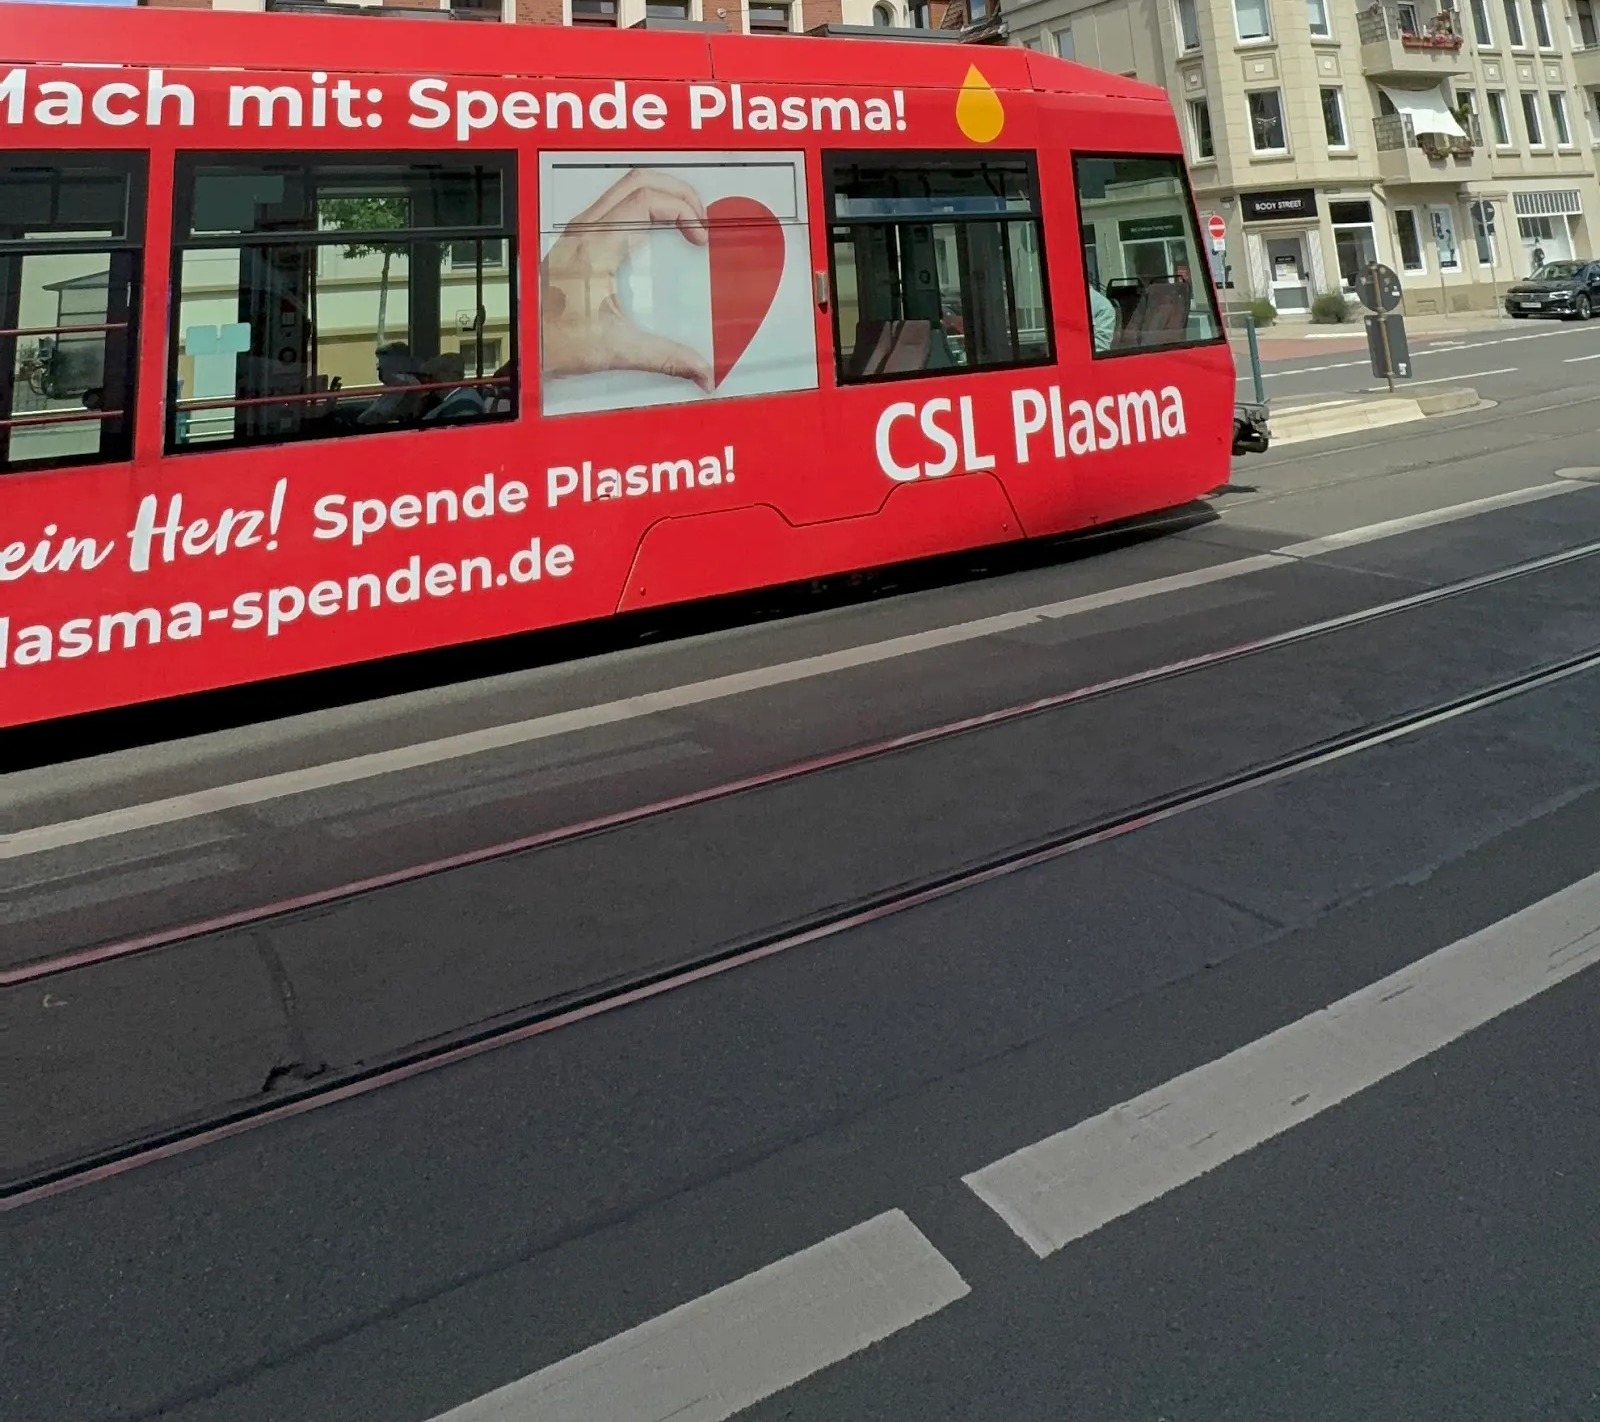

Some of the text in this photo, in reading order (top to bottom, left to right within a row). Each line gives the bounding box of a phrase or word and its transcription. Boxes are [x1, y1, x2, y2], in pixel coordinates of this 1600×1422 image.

[228, 72, 383, 128] mit:
[407, 77, 668, 142] Spende
[689, 83, 907, 131] Plasma!
[1255, 200, 1302, 210] BODY STREET
[875, 385, 1188, 482] CSL Plasma
[126, 477, 288, 573] Herz!
[312, 472, 529, 546] Spende
[547, 445, 736, 508] Plasma!
